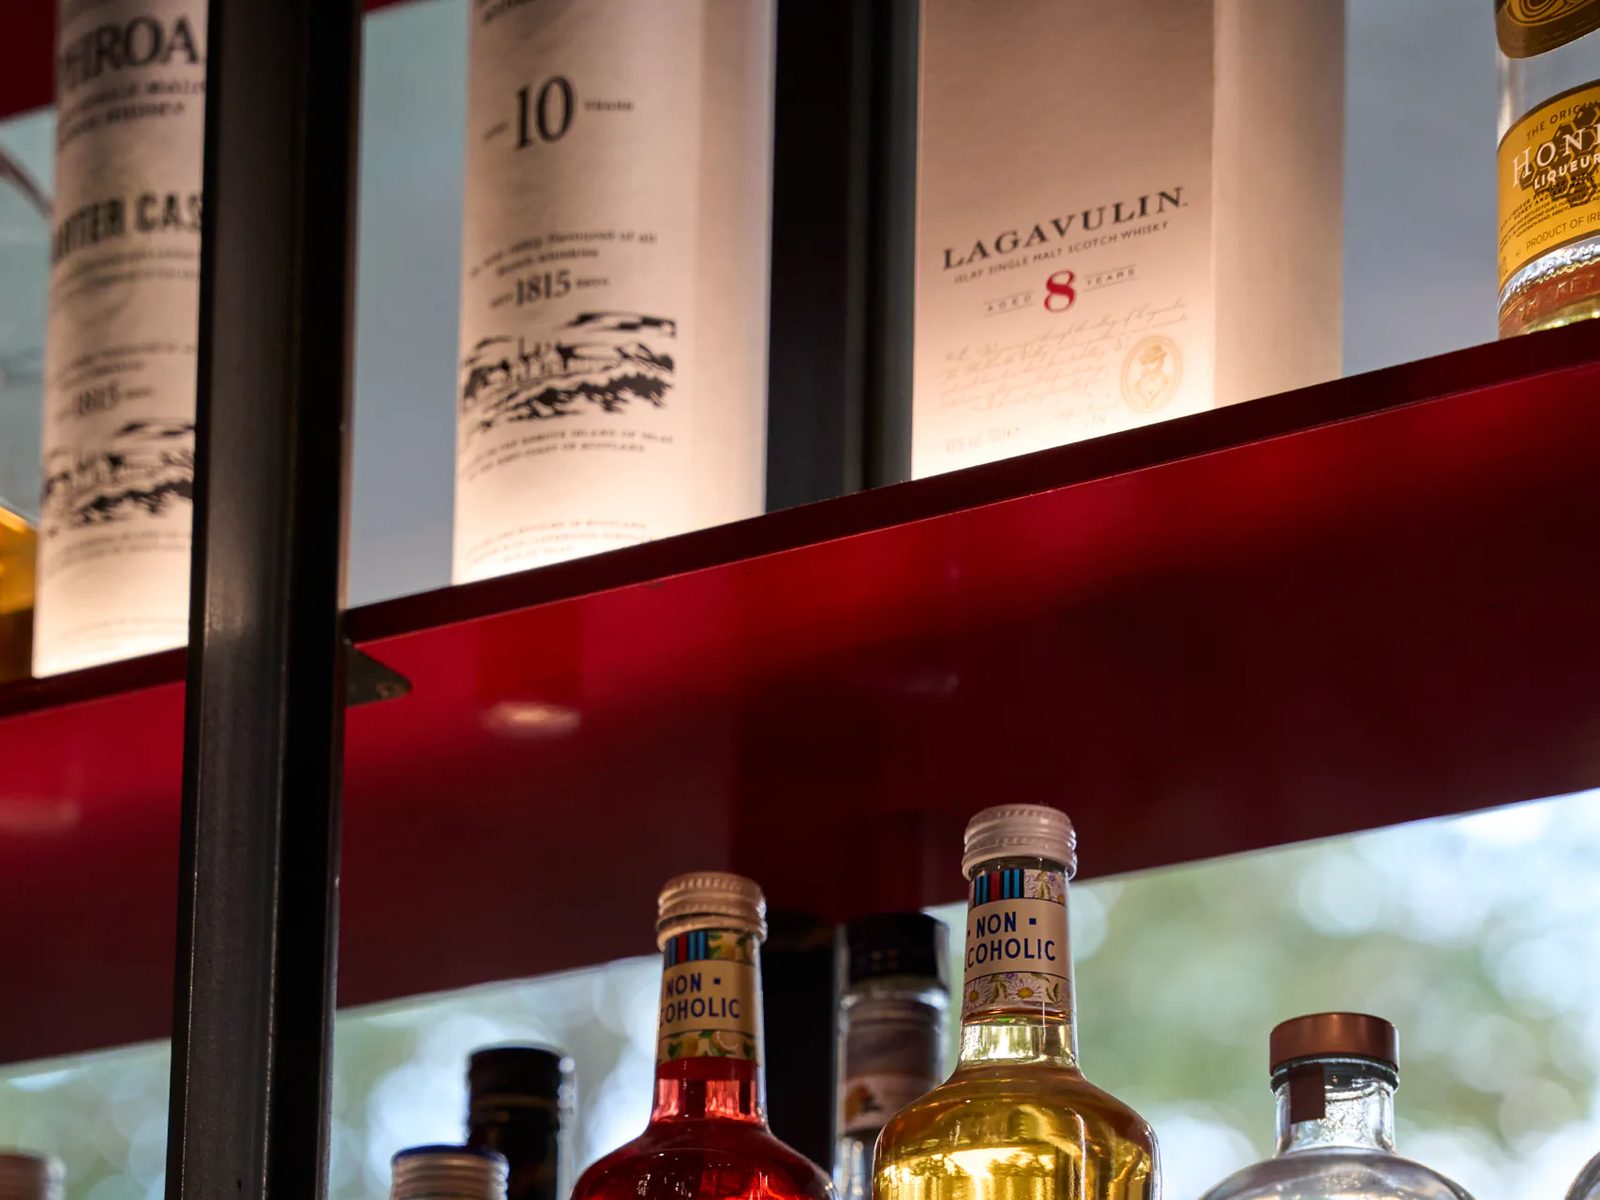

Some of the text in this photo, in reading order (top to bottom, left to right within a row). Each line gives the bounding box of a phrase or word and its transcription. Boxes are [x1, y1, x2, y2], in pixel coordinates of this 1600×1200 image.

[515, 75, 576, 149] 10
[1526, 120, 1545, 141] THE
[1534, 153, 1600, 190] LIQUEUR
[943, 186, 1185, 271] LAGAVULIN
[1526, 222, 1567, 250] PRODUCT
[1569, 215, 1584, 229] OF
[988, 255, 1028, 275] SINGLE
[1033, 247, 1063, 265] MALT
[1068, 233, 1118, 255] SCOTCH
[1120, 221, 1169, 241] WHISKY
[986, 267, 1136, 314] AGED 8 YEARS
[976, 911, 1017, 938] NON
[666, 972, 702, 998] NON
